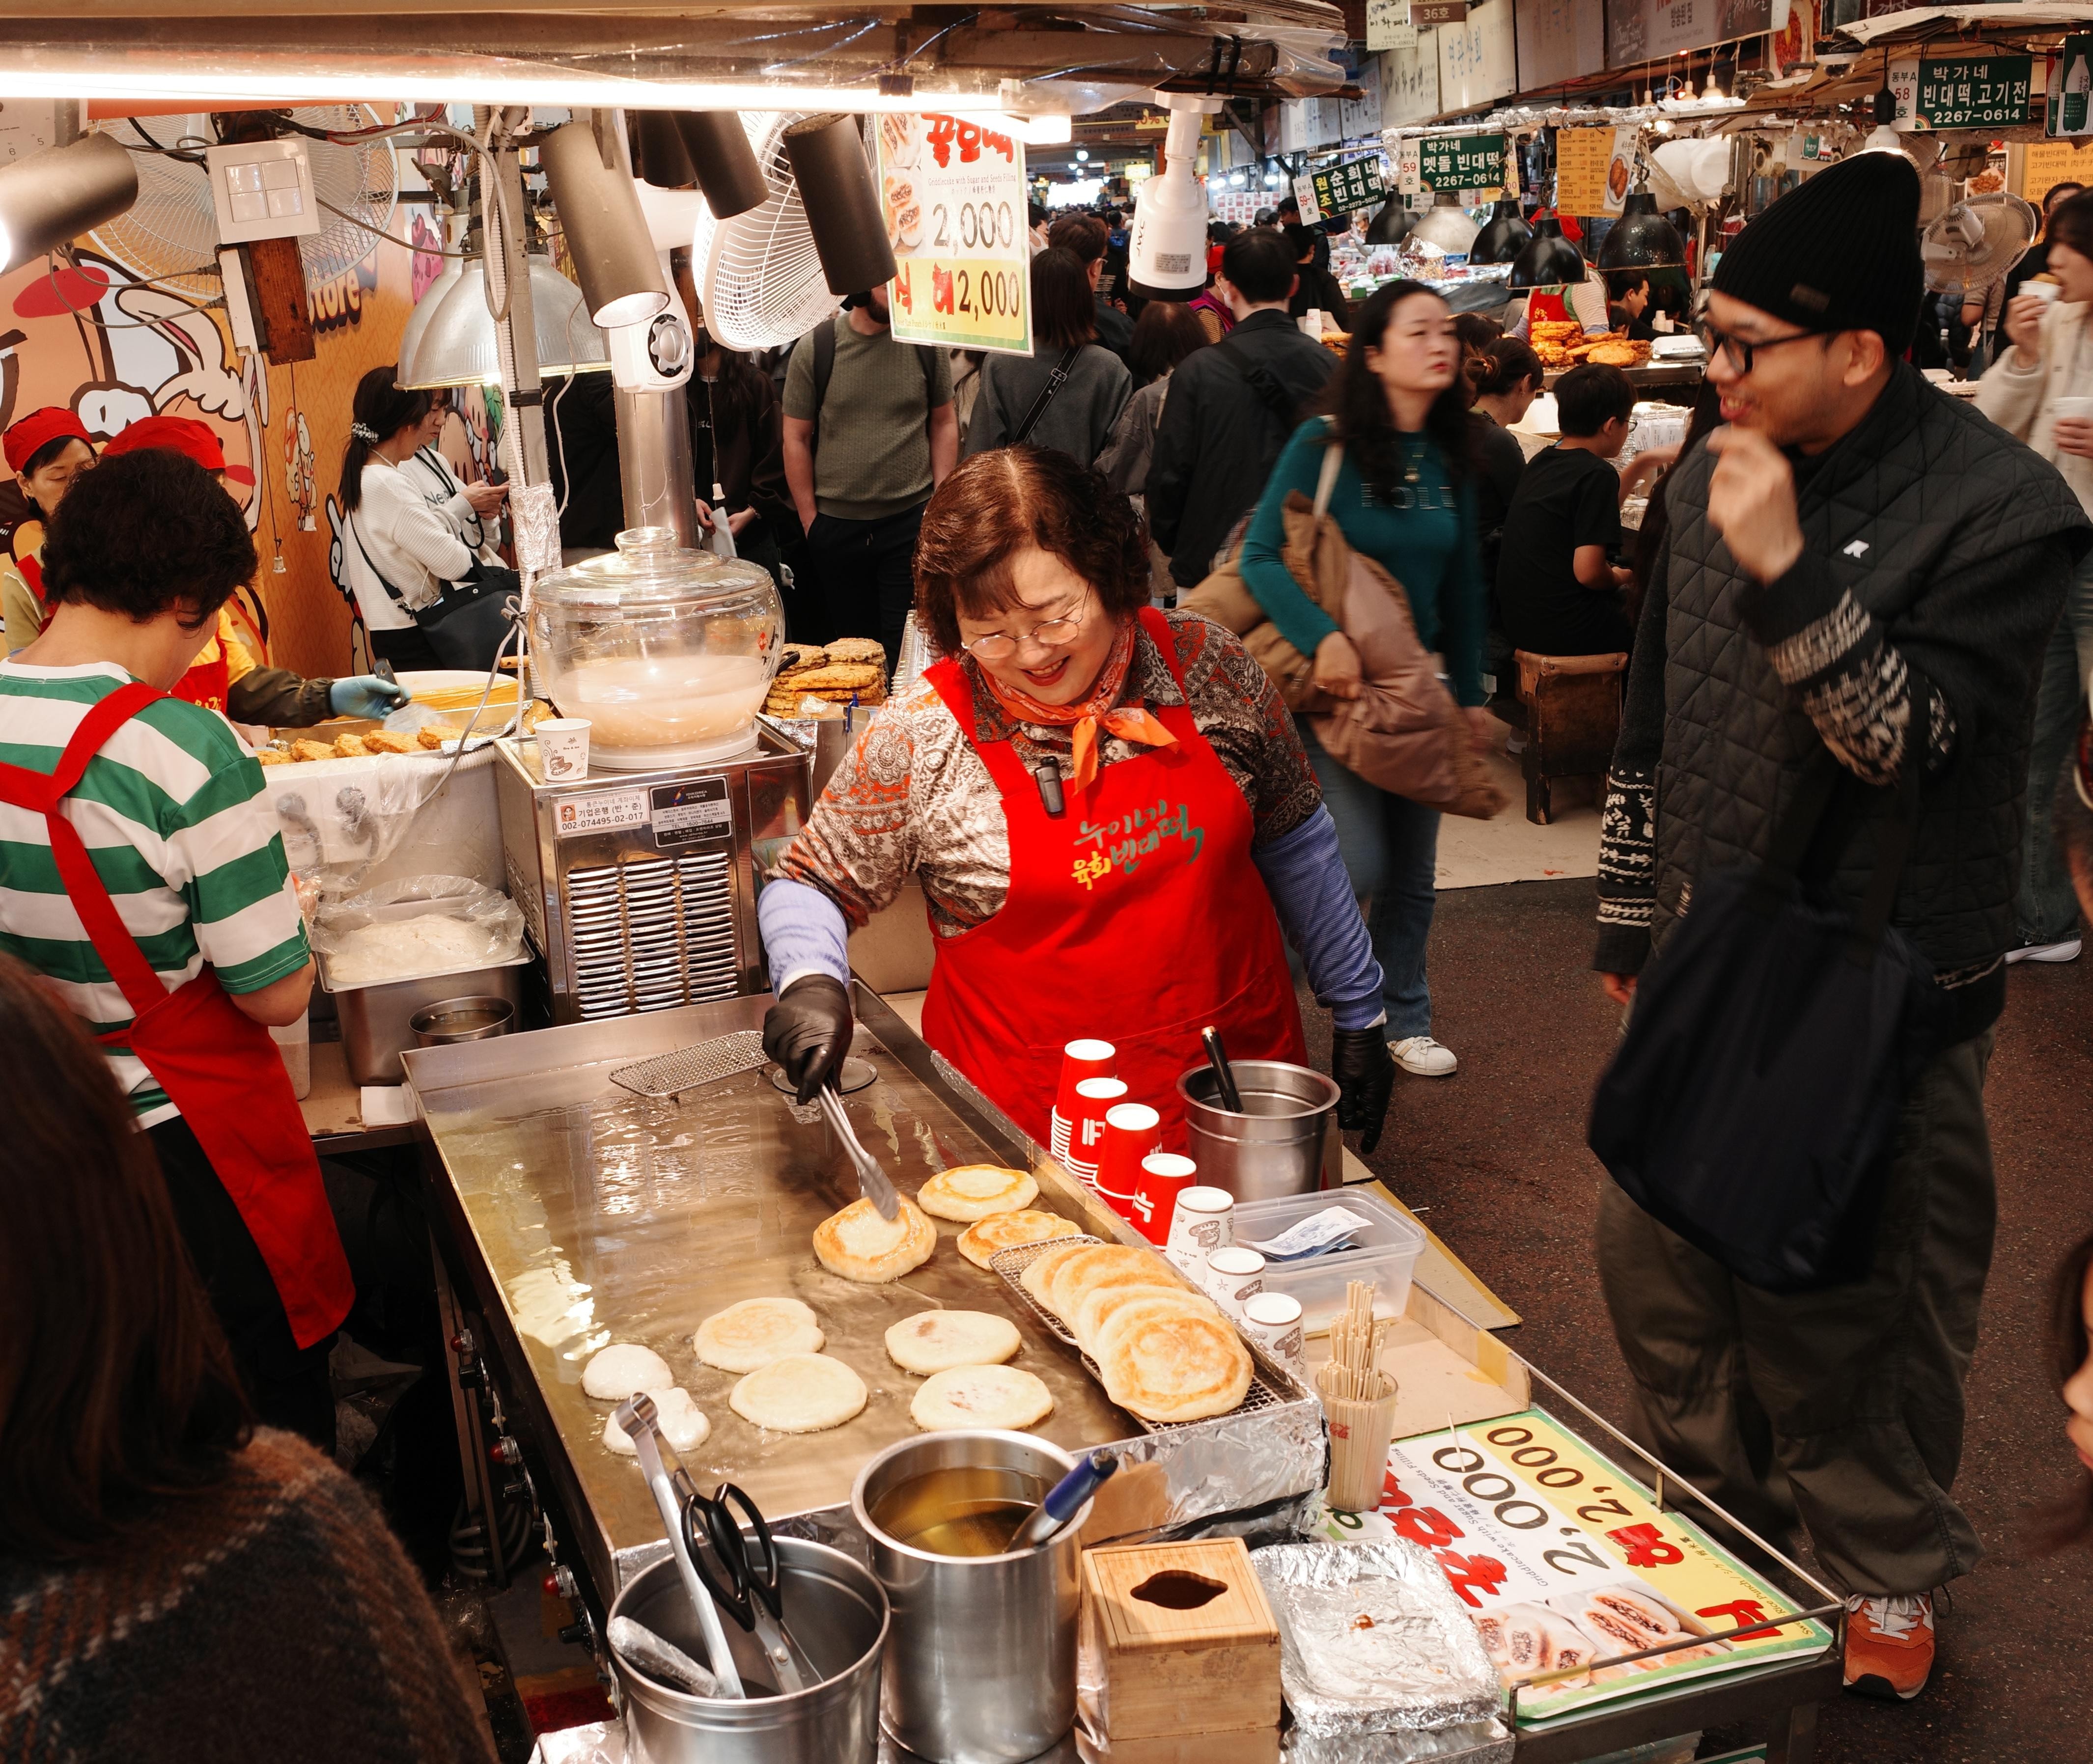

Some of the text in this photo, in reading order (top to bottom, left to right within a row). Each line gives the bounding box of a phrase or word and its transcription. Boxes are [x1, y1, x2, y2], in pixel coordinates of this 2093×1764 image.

[1423, 7, 1450, 20] 36호
[1895, 87, 1910, 100] 58
[1896, 106, 1908, 118] 호
[1933, 108, 2020, 123] 2267-0614
[1427, 139, 1461, 153] 박가네
[1403, 162, 1416, 173] 59
[1457, 151, 1500, 171] 빈대떡
[1404, 176, 1415, 185] 호
[1435, 172, 1500, 188] 2267-0614
[1333, 175, 1383, 203] 빈대떡
[1299, 194, 1315, 207] 59-1
[1338, 195, 1379, 212] 02-2273-5057
[1307, 207, 1314, 216] 호
[932, 201, 1014, 256] 2,000
[957, 269, 1020, 322] 2,000
[579, 806, 609, 818] 기업은행
[562, 812, 643, 830] 002-074495-02-017
[686, 819, 713, 827] 1600-7644
[1486, 1427, 1634, 1523] 2,000
[1391, 1448, 1549, 1587] Griddlecake with Sugar and Seeds Filling
[1432, 1446, 1611, 1575] 2,000
[1739, 1579, 1767, 1600] Punch
